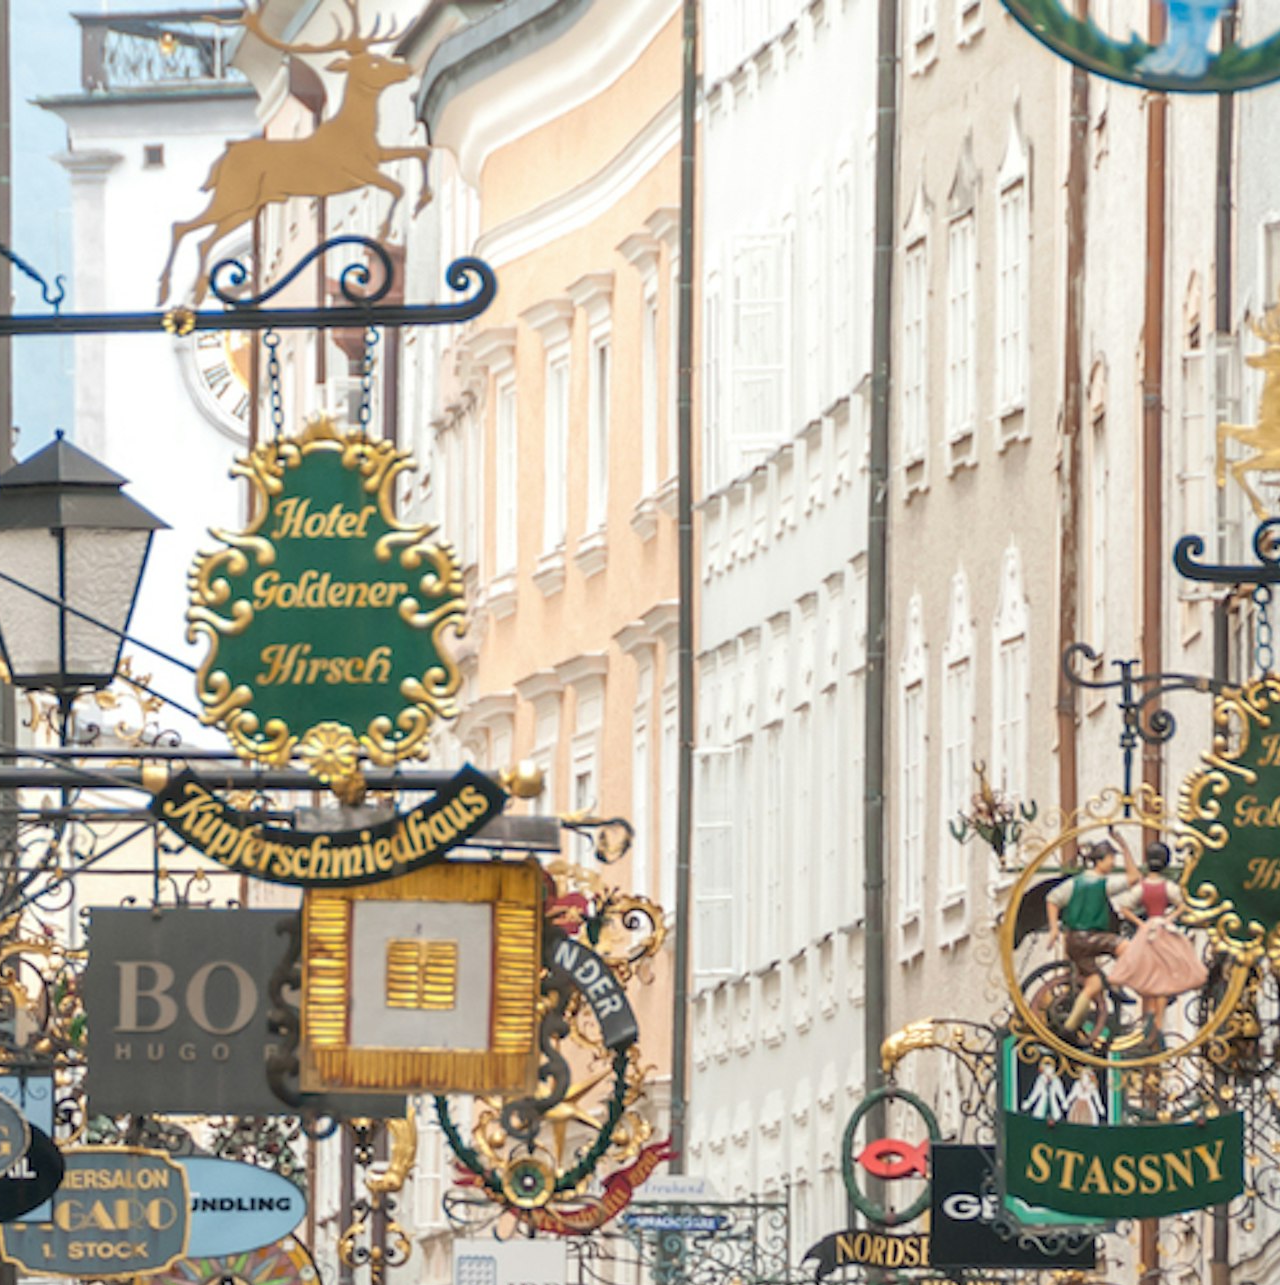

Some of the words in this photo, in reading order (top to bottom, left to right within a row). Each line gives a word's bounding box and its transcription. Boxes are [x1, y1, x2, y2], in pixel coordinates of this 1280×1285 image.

[271, 497, 377, 541] Hotel
[252, 569, 408, 609] Goldener
[255, 642, 393, 687] Hirsch
[164, 782, 490, 880] Kupferschmiedhaus
[115, 1042, 230, 1062] HUGO
[1025, 1140, 1225, 1197] STASSNY
[67, 1241, 149, 1260] STOCK
